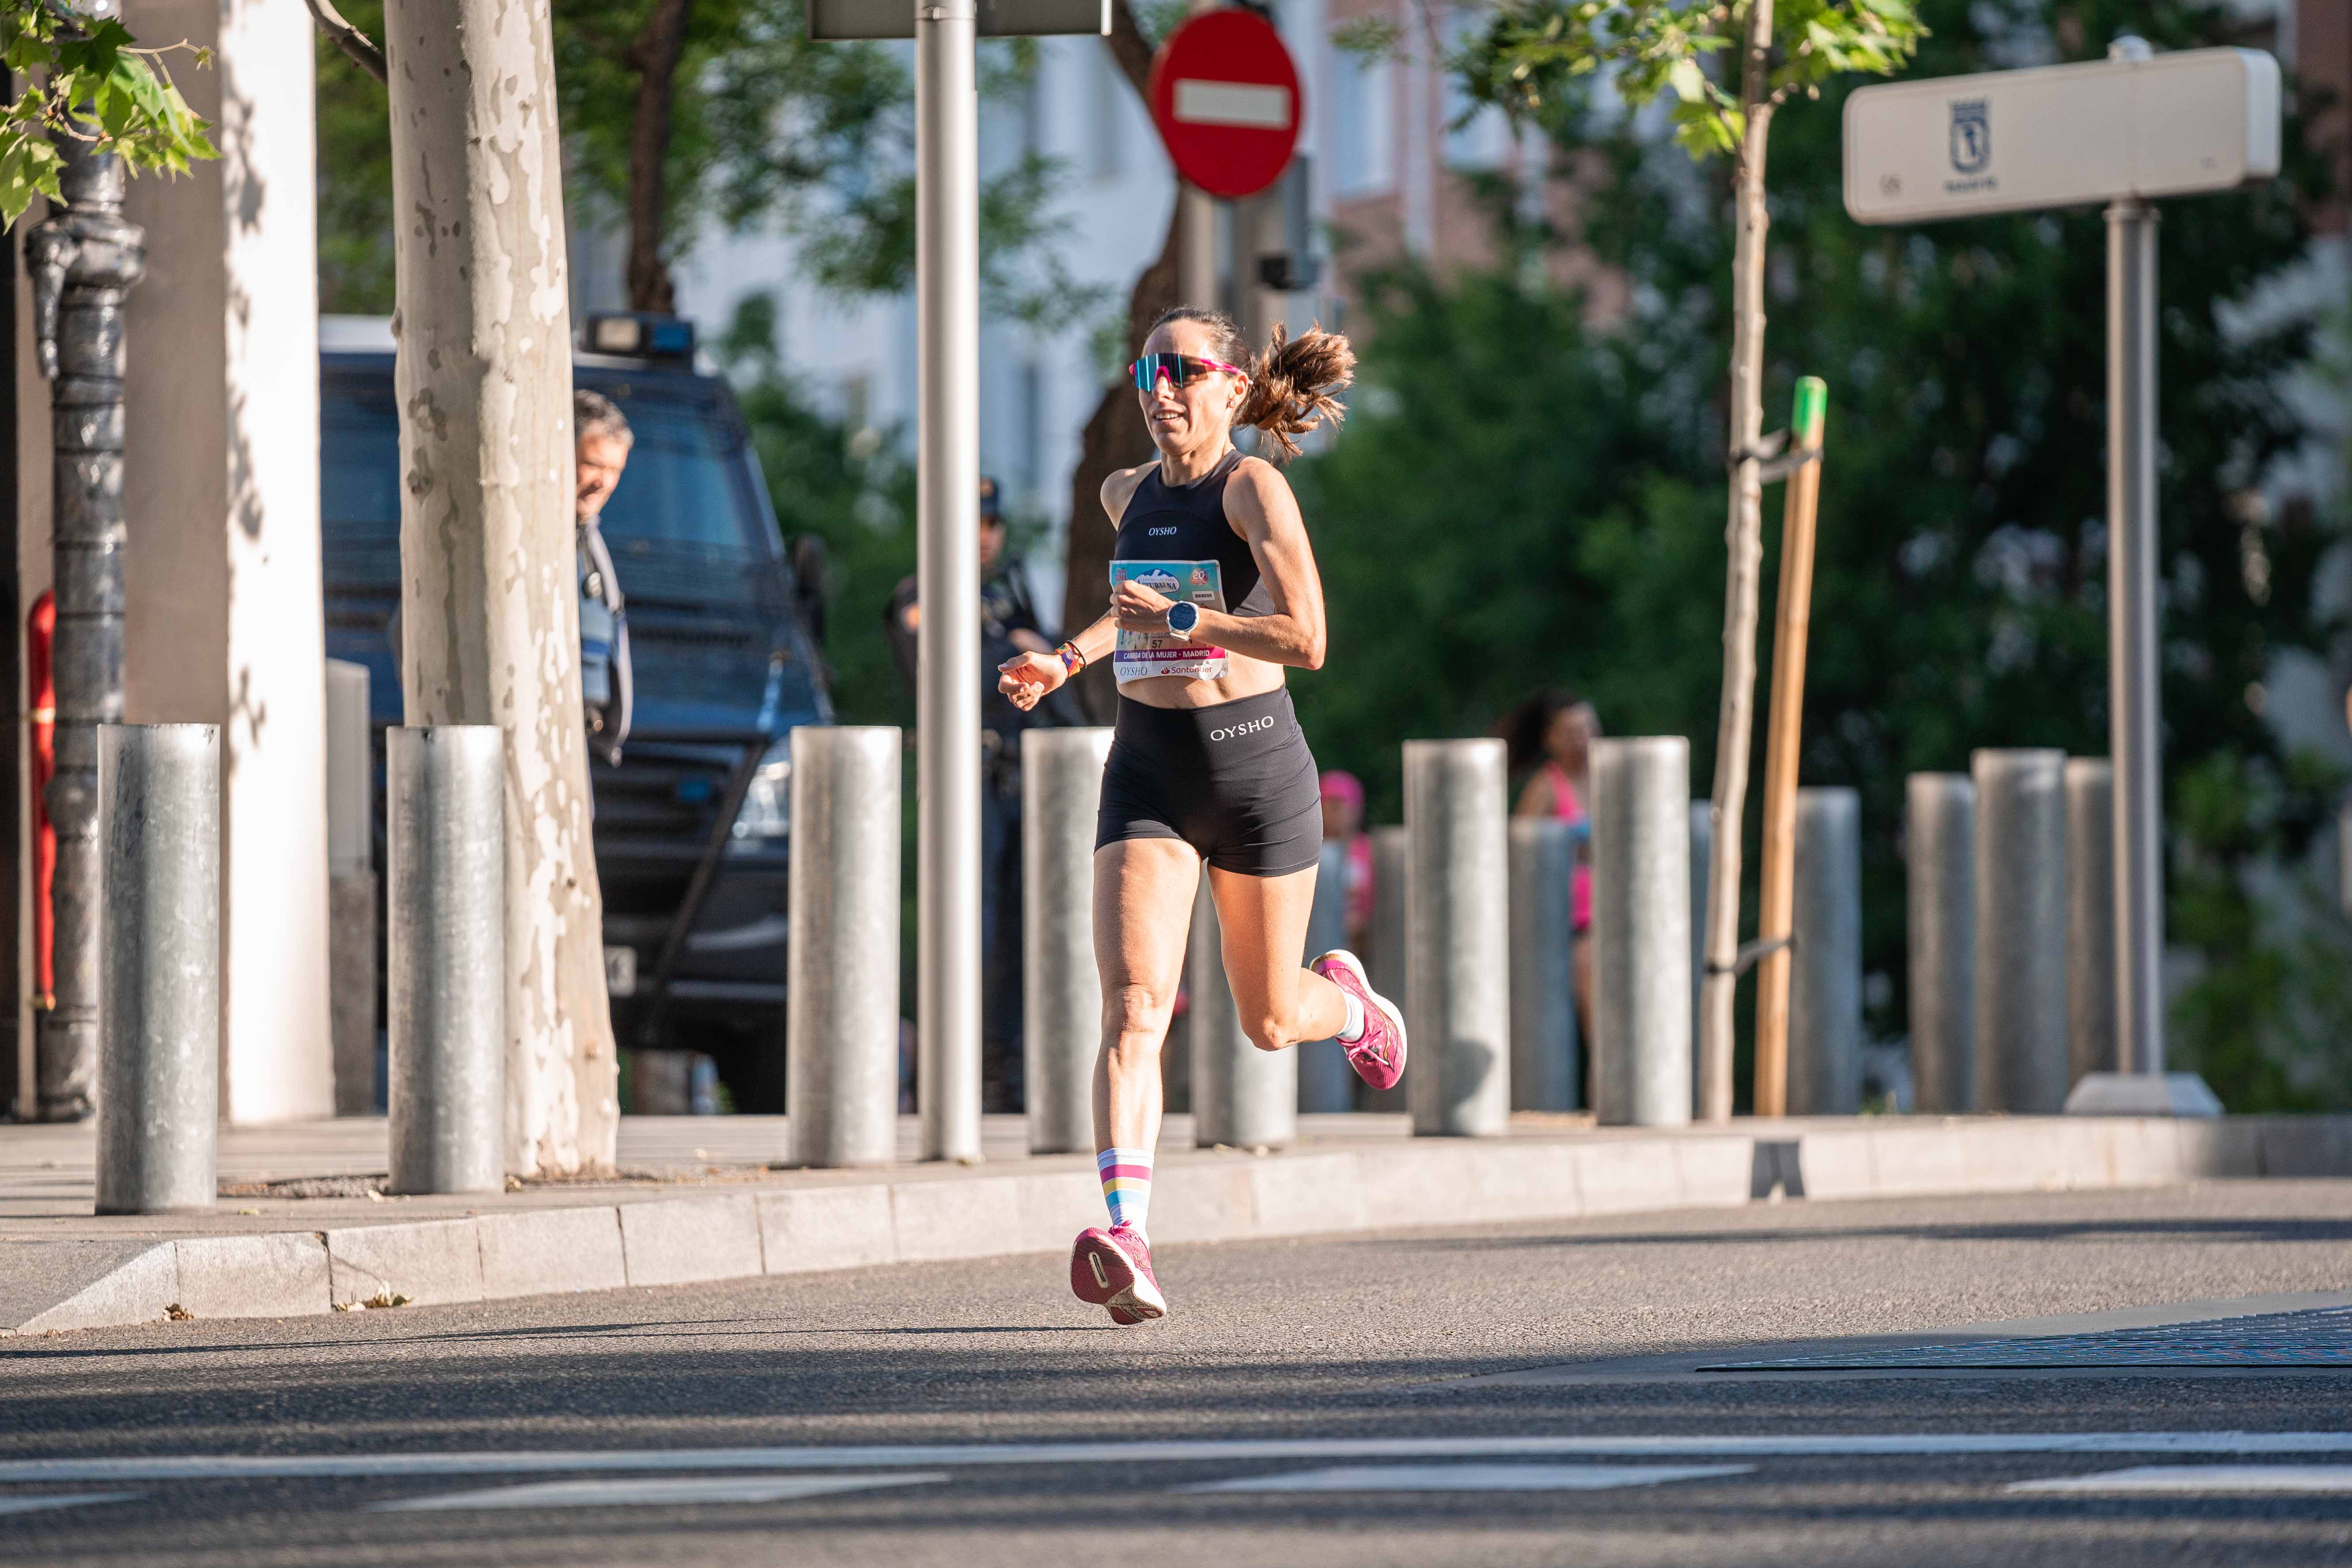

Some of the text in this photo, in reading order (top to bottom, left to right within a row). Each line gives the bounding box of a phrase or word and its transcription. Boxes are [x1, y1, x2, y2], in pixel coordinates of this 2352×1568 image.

[1149, 526, 1177, 536] OYSHO
[1193, 571, 1205, 579] 20
[1152, 640, 1163, 648] 57
[1120, 665, 1148, 676] OYSHO
[1210, 716, 1274, 741] OYSHO
